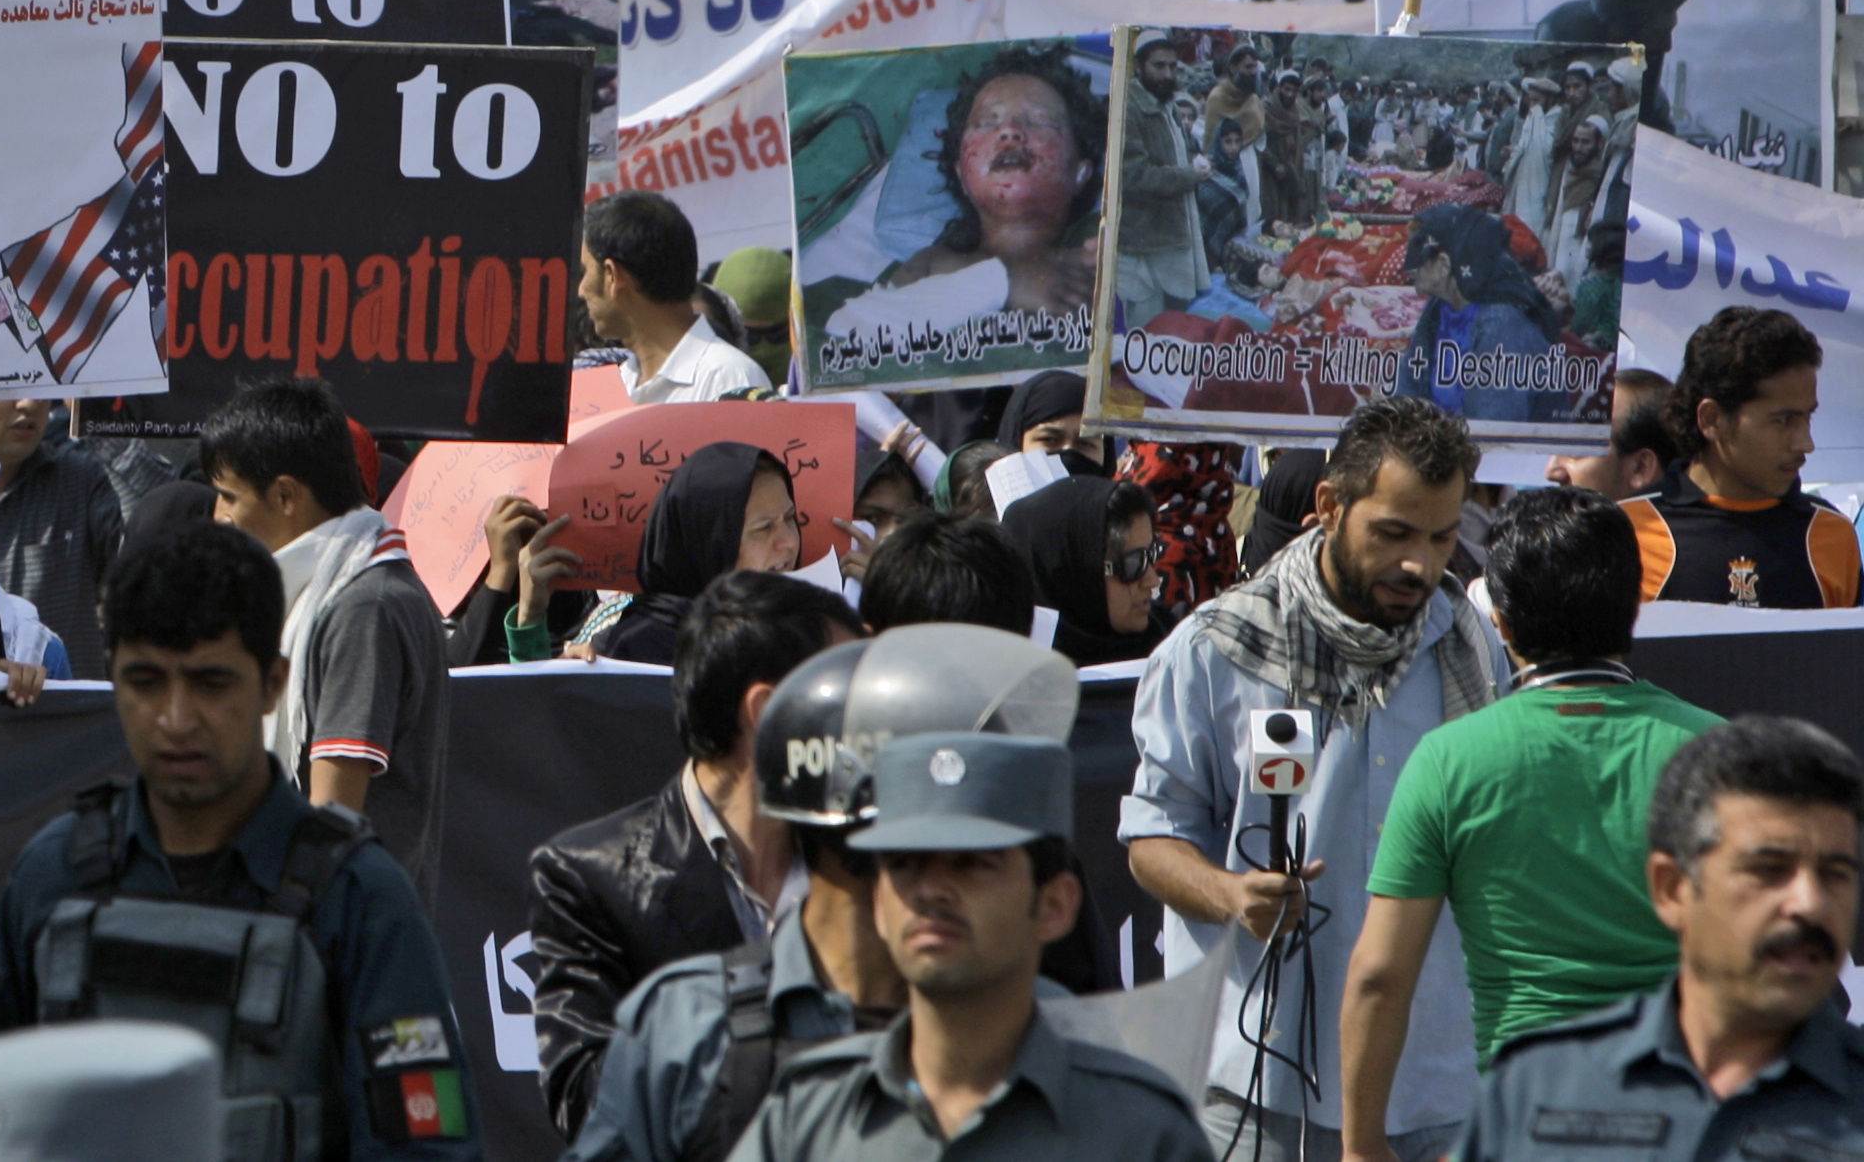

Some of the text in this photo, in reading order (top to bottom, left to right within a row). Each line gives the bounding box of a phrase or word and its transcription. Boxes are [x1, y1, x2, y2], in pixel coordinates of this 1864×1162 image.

[1, 0, 49, 24] معاهده
[163, 60, 337, 177] NO
[396, 64, 541, 181] to
[167, 235, 568, 378] ccupation
[1122, 327, 1285, 390] Occupation
[1320, 337, 1400, 397] killing
[1435, 340, 1601, 392] Destruction
[22, 370, 44, 383] حزب
[144, 421, 175, 437] Party
[179, 422, 192, 433] of
[609, 451, 625, 469] و
